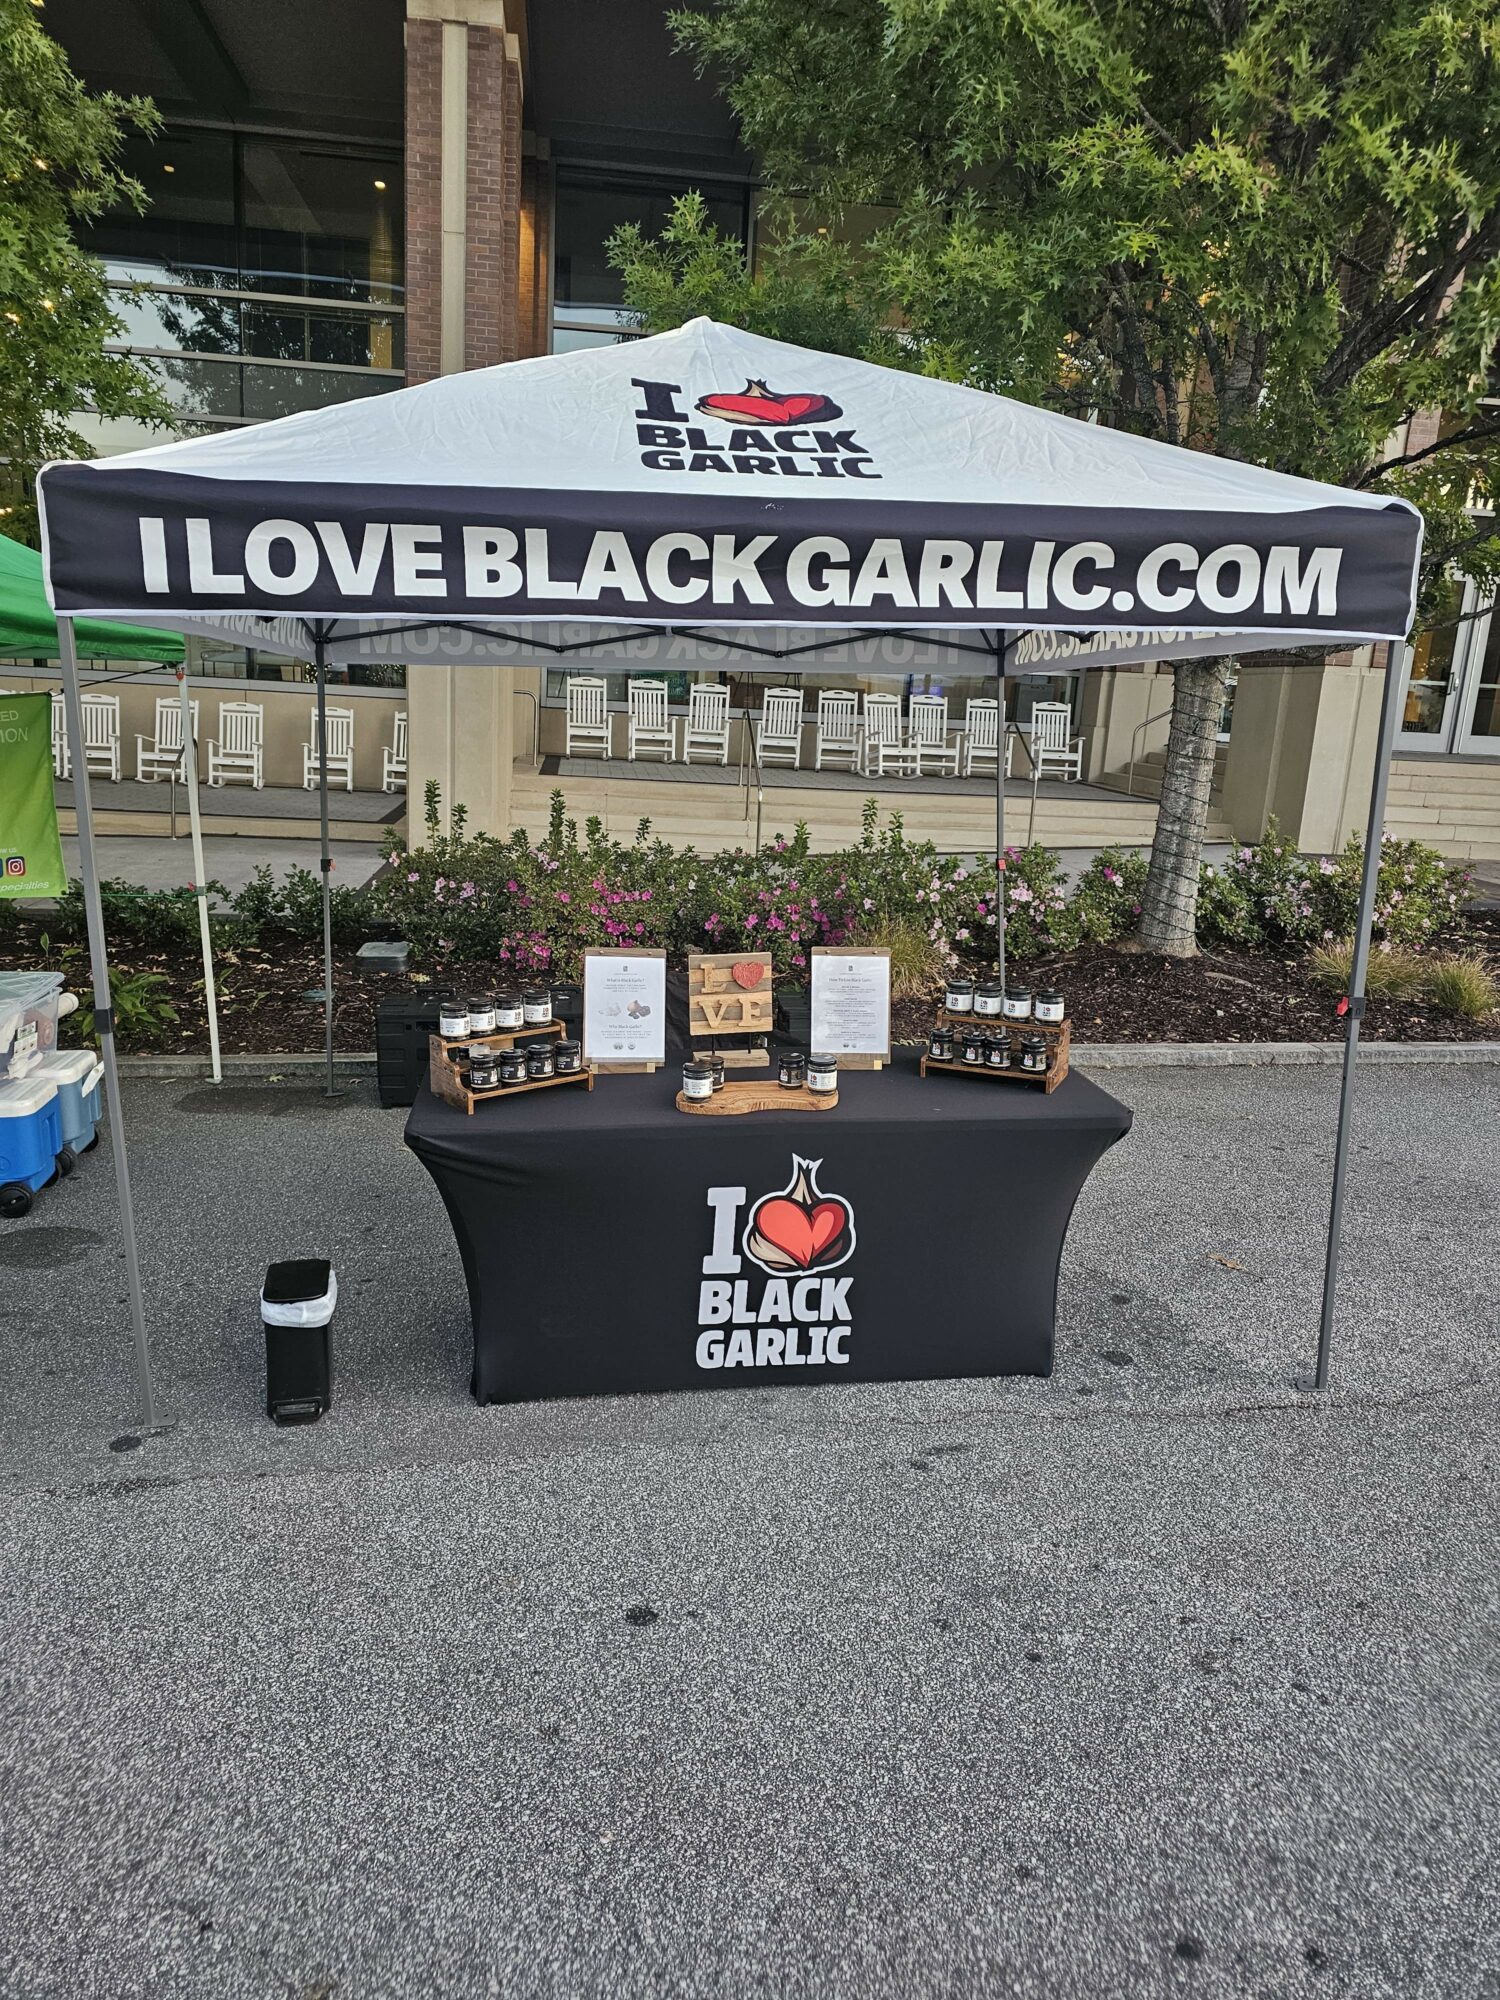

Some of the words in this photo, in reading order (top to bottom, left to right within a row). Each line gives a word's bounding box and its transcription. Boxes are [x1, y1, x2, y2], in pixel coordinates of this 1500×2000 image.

[631, 377, 689, 422] I
[636, 423, 869, 453] BLACK
[641, 450, 883, 479] GARLIC
[139, 517, 170, 593] I
[185, 518, 447, 597] LOVE
[463, 526, 775, 605] BLACK
[786, 537, 1343, 617] GARLIC.COM
[702, 1186, 747, 1275] I
[698, 1277, 854, 1325] BLACK
[695, 1326, 852, 1369] GARLIC
